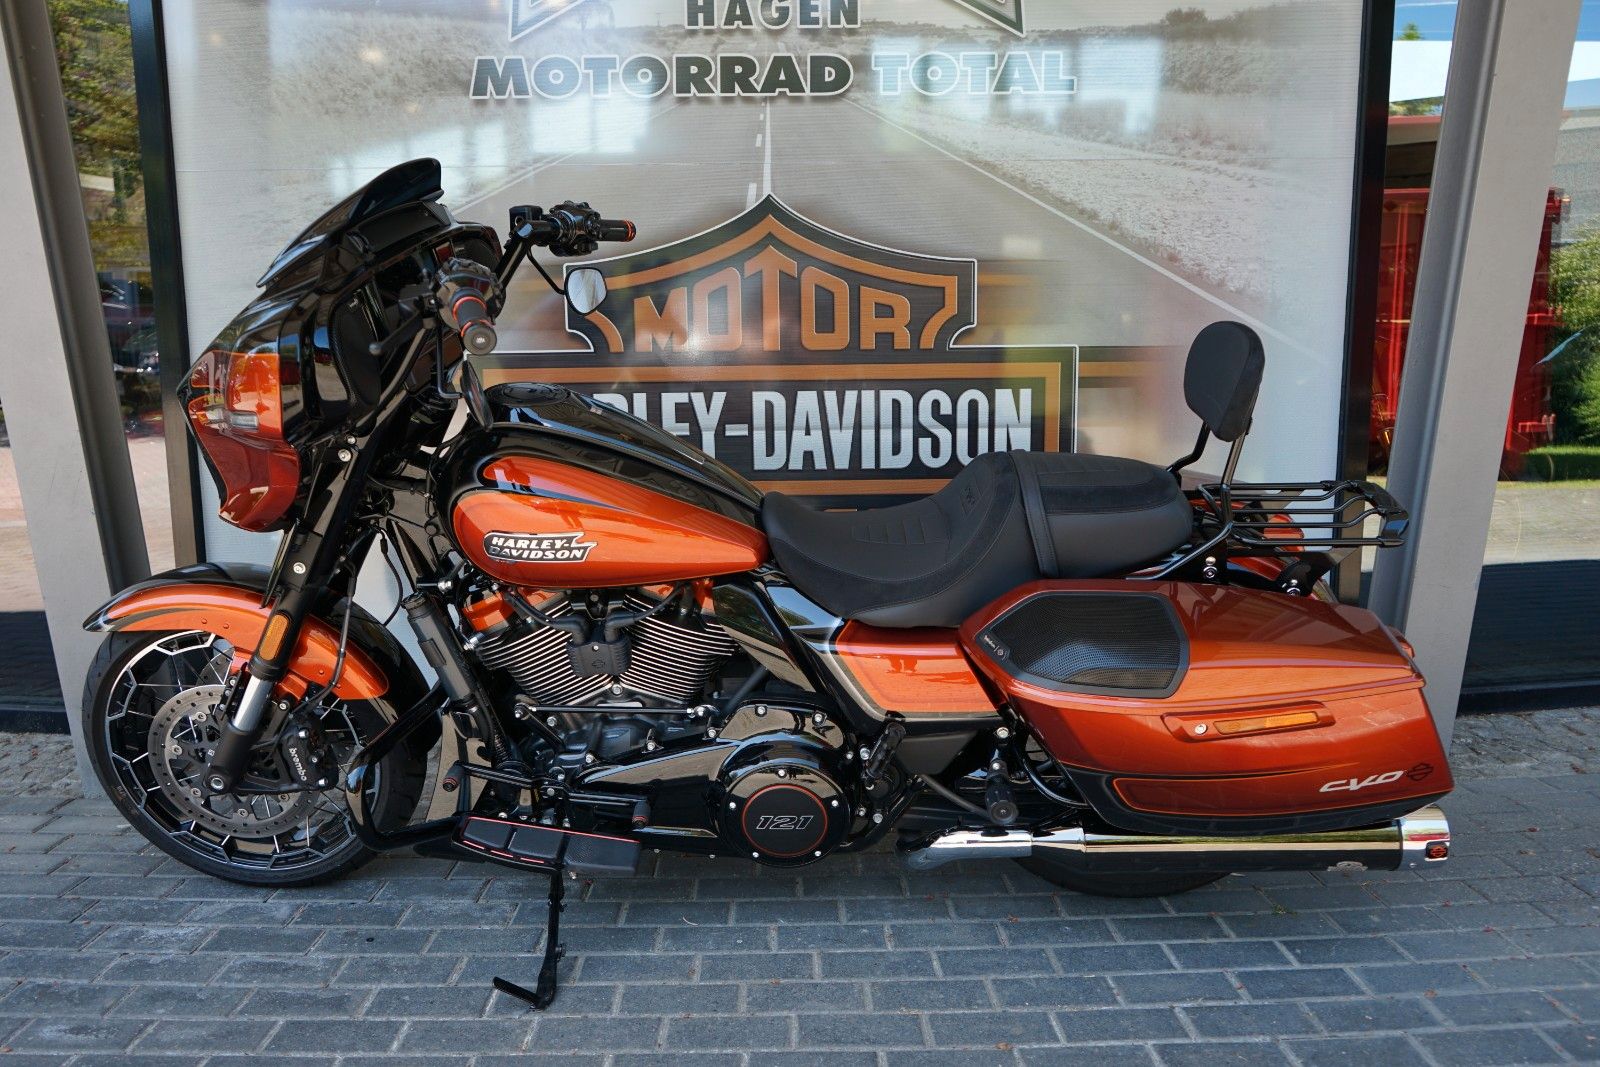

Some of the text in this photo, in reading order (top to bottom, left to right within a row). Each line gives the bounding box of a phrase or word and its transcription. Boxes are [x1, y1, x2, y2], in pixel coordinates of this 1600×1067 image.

[685, 0, 861, 29] HAGEN
[469, 50, 1077, 100] MOTORRAD TOTAL
[633, 244, 911, 352] MOTOR
[488, 545, 585, 560] DAVIDSON
[491, 536, 570, 549] HARLEY-
[289, 747, 307, 781] brembo
[1319, 769, 1407, 793] CVO
[756, 815, 814, 830] 121
